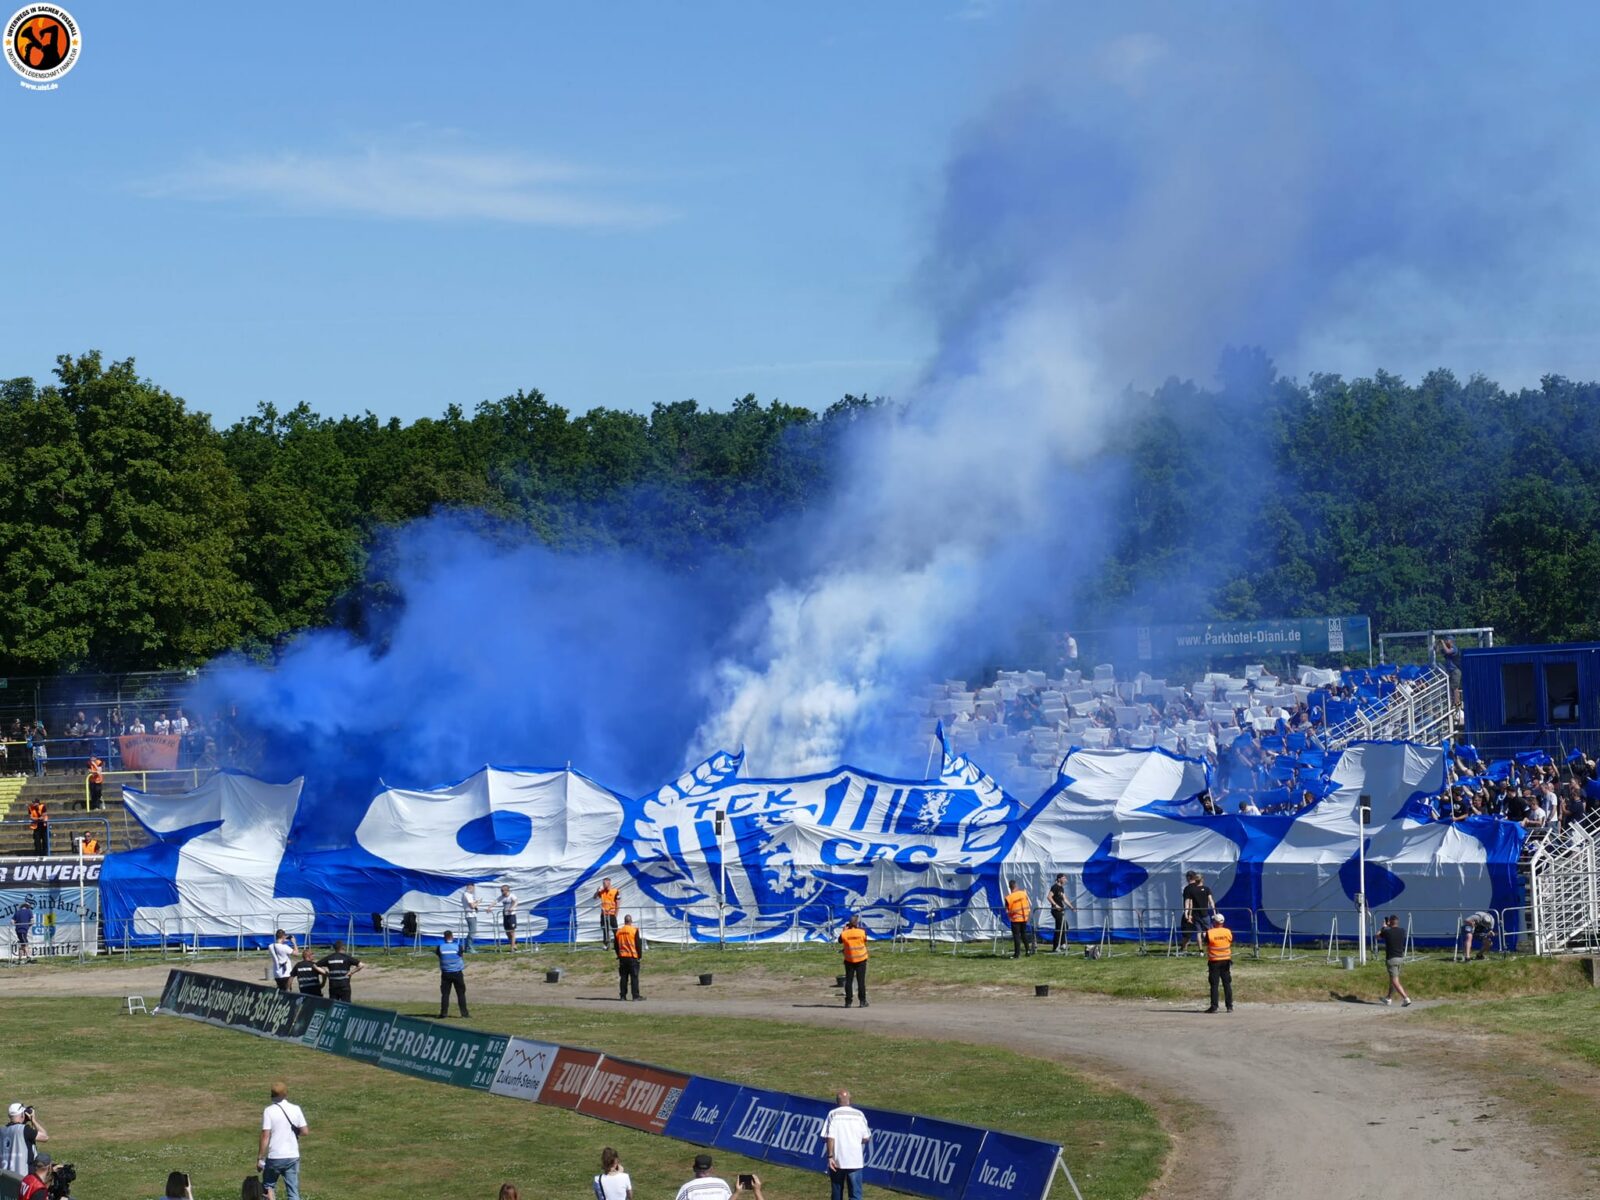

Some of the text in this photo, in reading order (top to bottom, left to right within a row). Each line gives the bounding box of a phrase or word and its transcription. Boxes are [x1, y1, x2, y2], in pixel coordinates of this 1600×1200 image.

[1176, 630, 1301, 646] www.Parkhotel-Diani.de
[819, 838, 938, 873] CFC
[13, 864, 101, 881] UNVERG
[11, 942, 79, 956] Cemnitz
[178, 976, 207, 1007] Unsere
[204, 979, 232, 1012] Saison
[226, 987, 255, 1024] geht
[249, 992, 273, 1022] 365
[325, 1021, 341, 1033] PRO
[319, 1035, 336, 1047] BAU
[344, 1017, 480, 1069] WWW.REPROBAU.DE
[480, 1056, 499, 1069] PRO
[474, 1071, 494, 1085] BAU
[496, 1070, 540, 1090] Zukunft-Steine
[553, 1062, 622, 1104] ZUKUNFT
[619, 1079, 665, 1115] STEIN
[691, 1101, 719, 1125] lvz.de
[978, 1160, 1017, 1191] lvz.de
